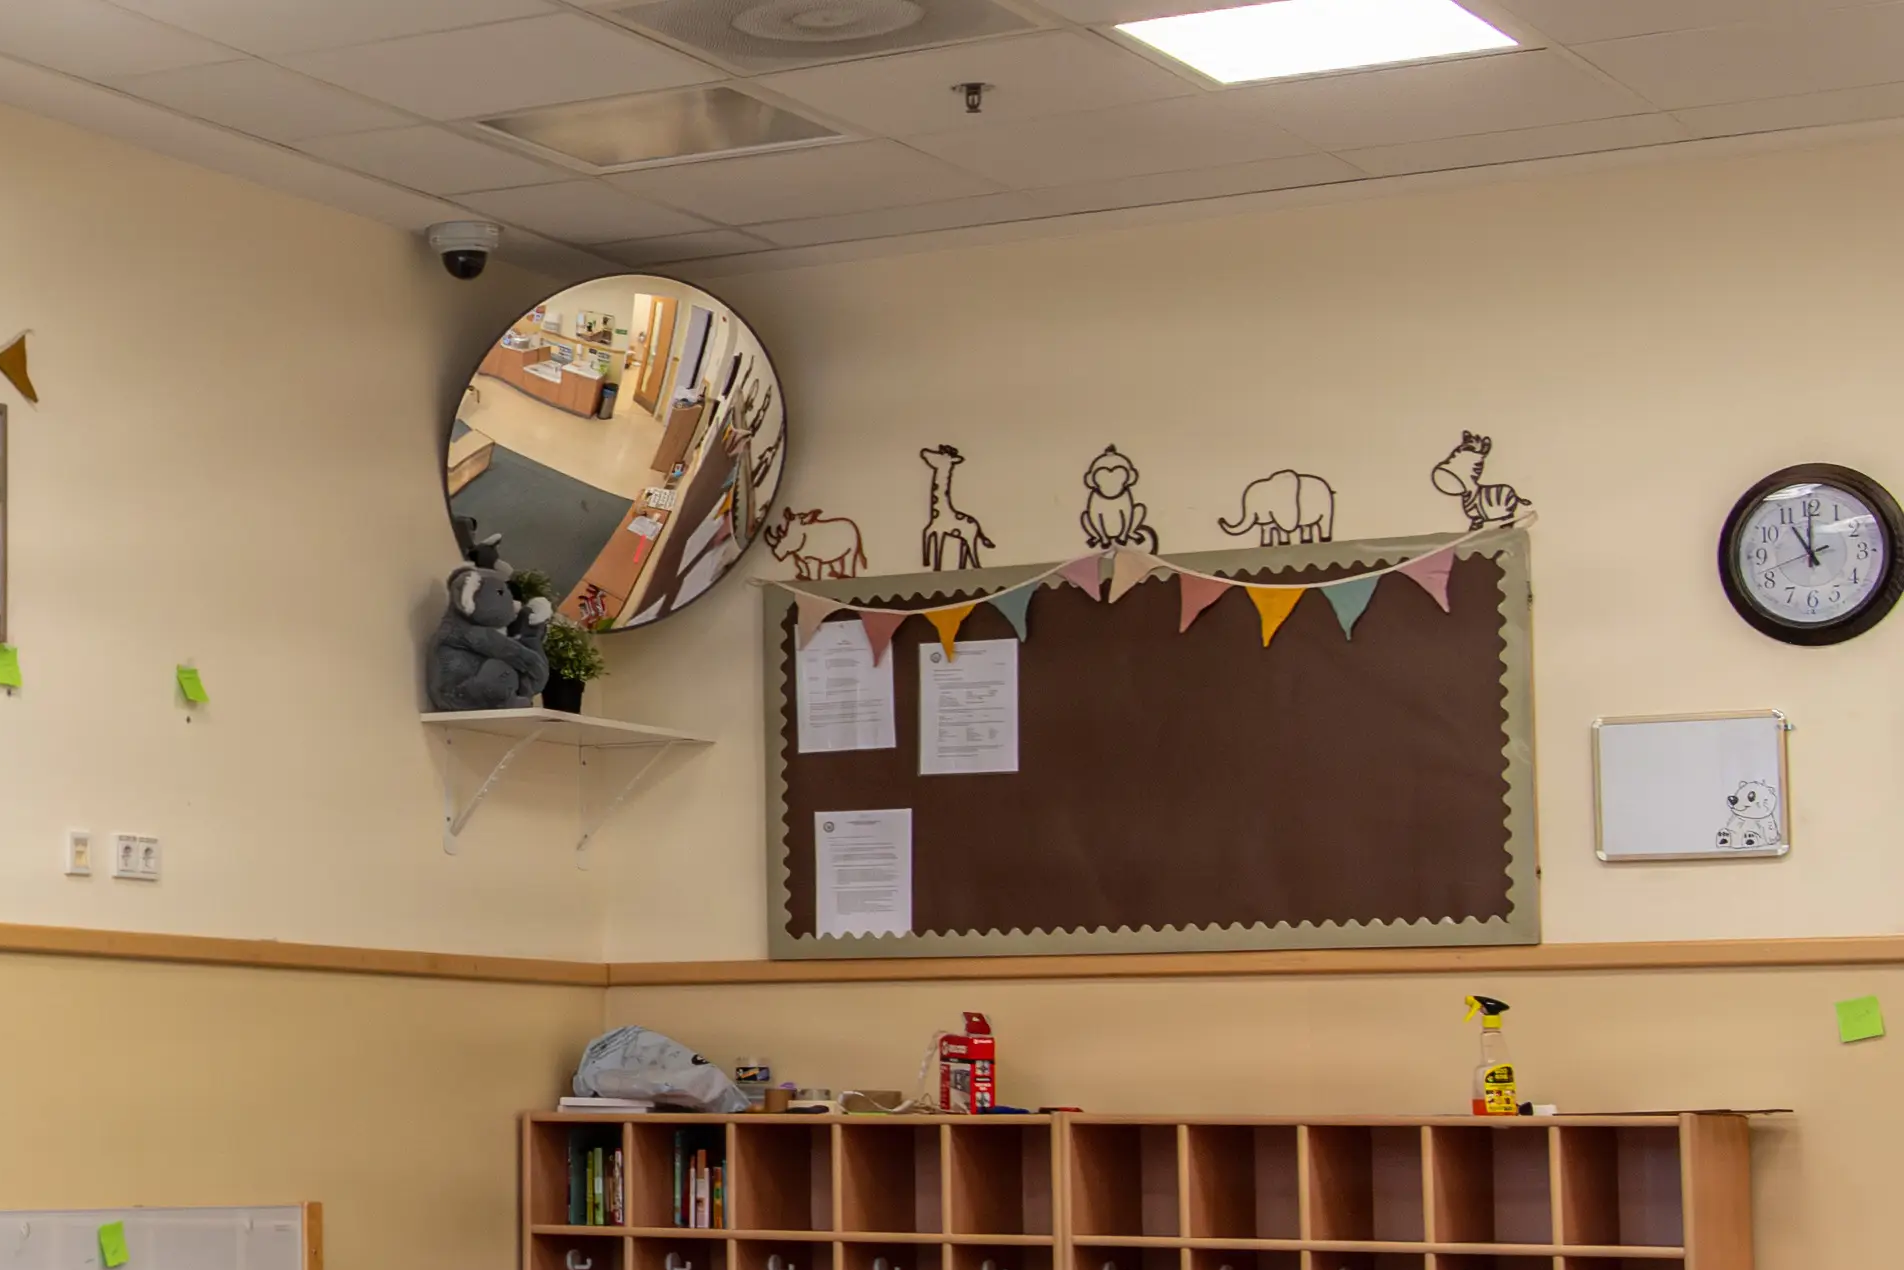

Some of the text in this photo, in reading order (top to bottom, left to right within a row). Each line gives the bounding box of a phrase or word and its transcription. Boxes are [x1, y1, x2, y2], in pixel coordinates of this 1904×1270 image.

[1780, 507, 1794, 525] 11
[1802, 499, 1821, 517] 12
[1833, 504, 1840, 521] 1
[1762, 525, 1779, 543] 10
[1848, 520, 1860, 538] 2
[1756, 548, 1768, 566] 9
[1856, 542, 1869, 560] 3
[1764, 571, 1776, 589] 8
[1848, 567, 1860, 584] 4
[1784, 586, 1796, 604] 7
[1807, 590, 1819, 608] 6
[1828, 585, 1841, 603] 5
